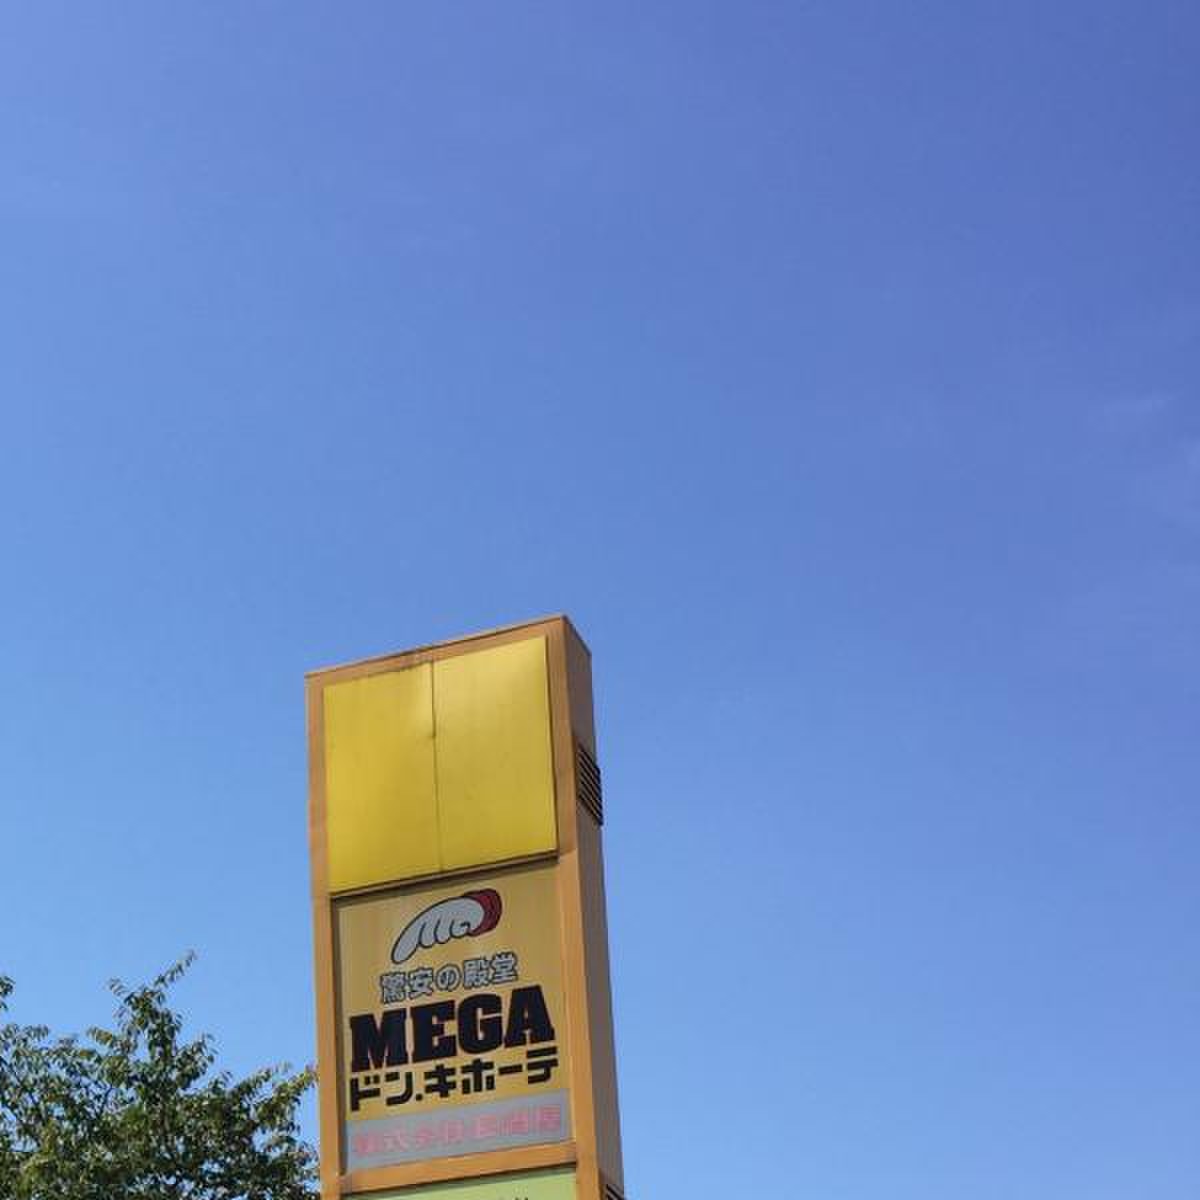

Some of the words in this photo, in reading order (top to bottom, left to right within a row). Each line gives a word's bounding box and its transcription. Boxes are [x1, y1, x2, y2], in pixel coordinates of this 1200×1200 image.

[380, 952, 518, 1004] 驚安の殿堂
[349, 984, 555, 1073] MEGA
